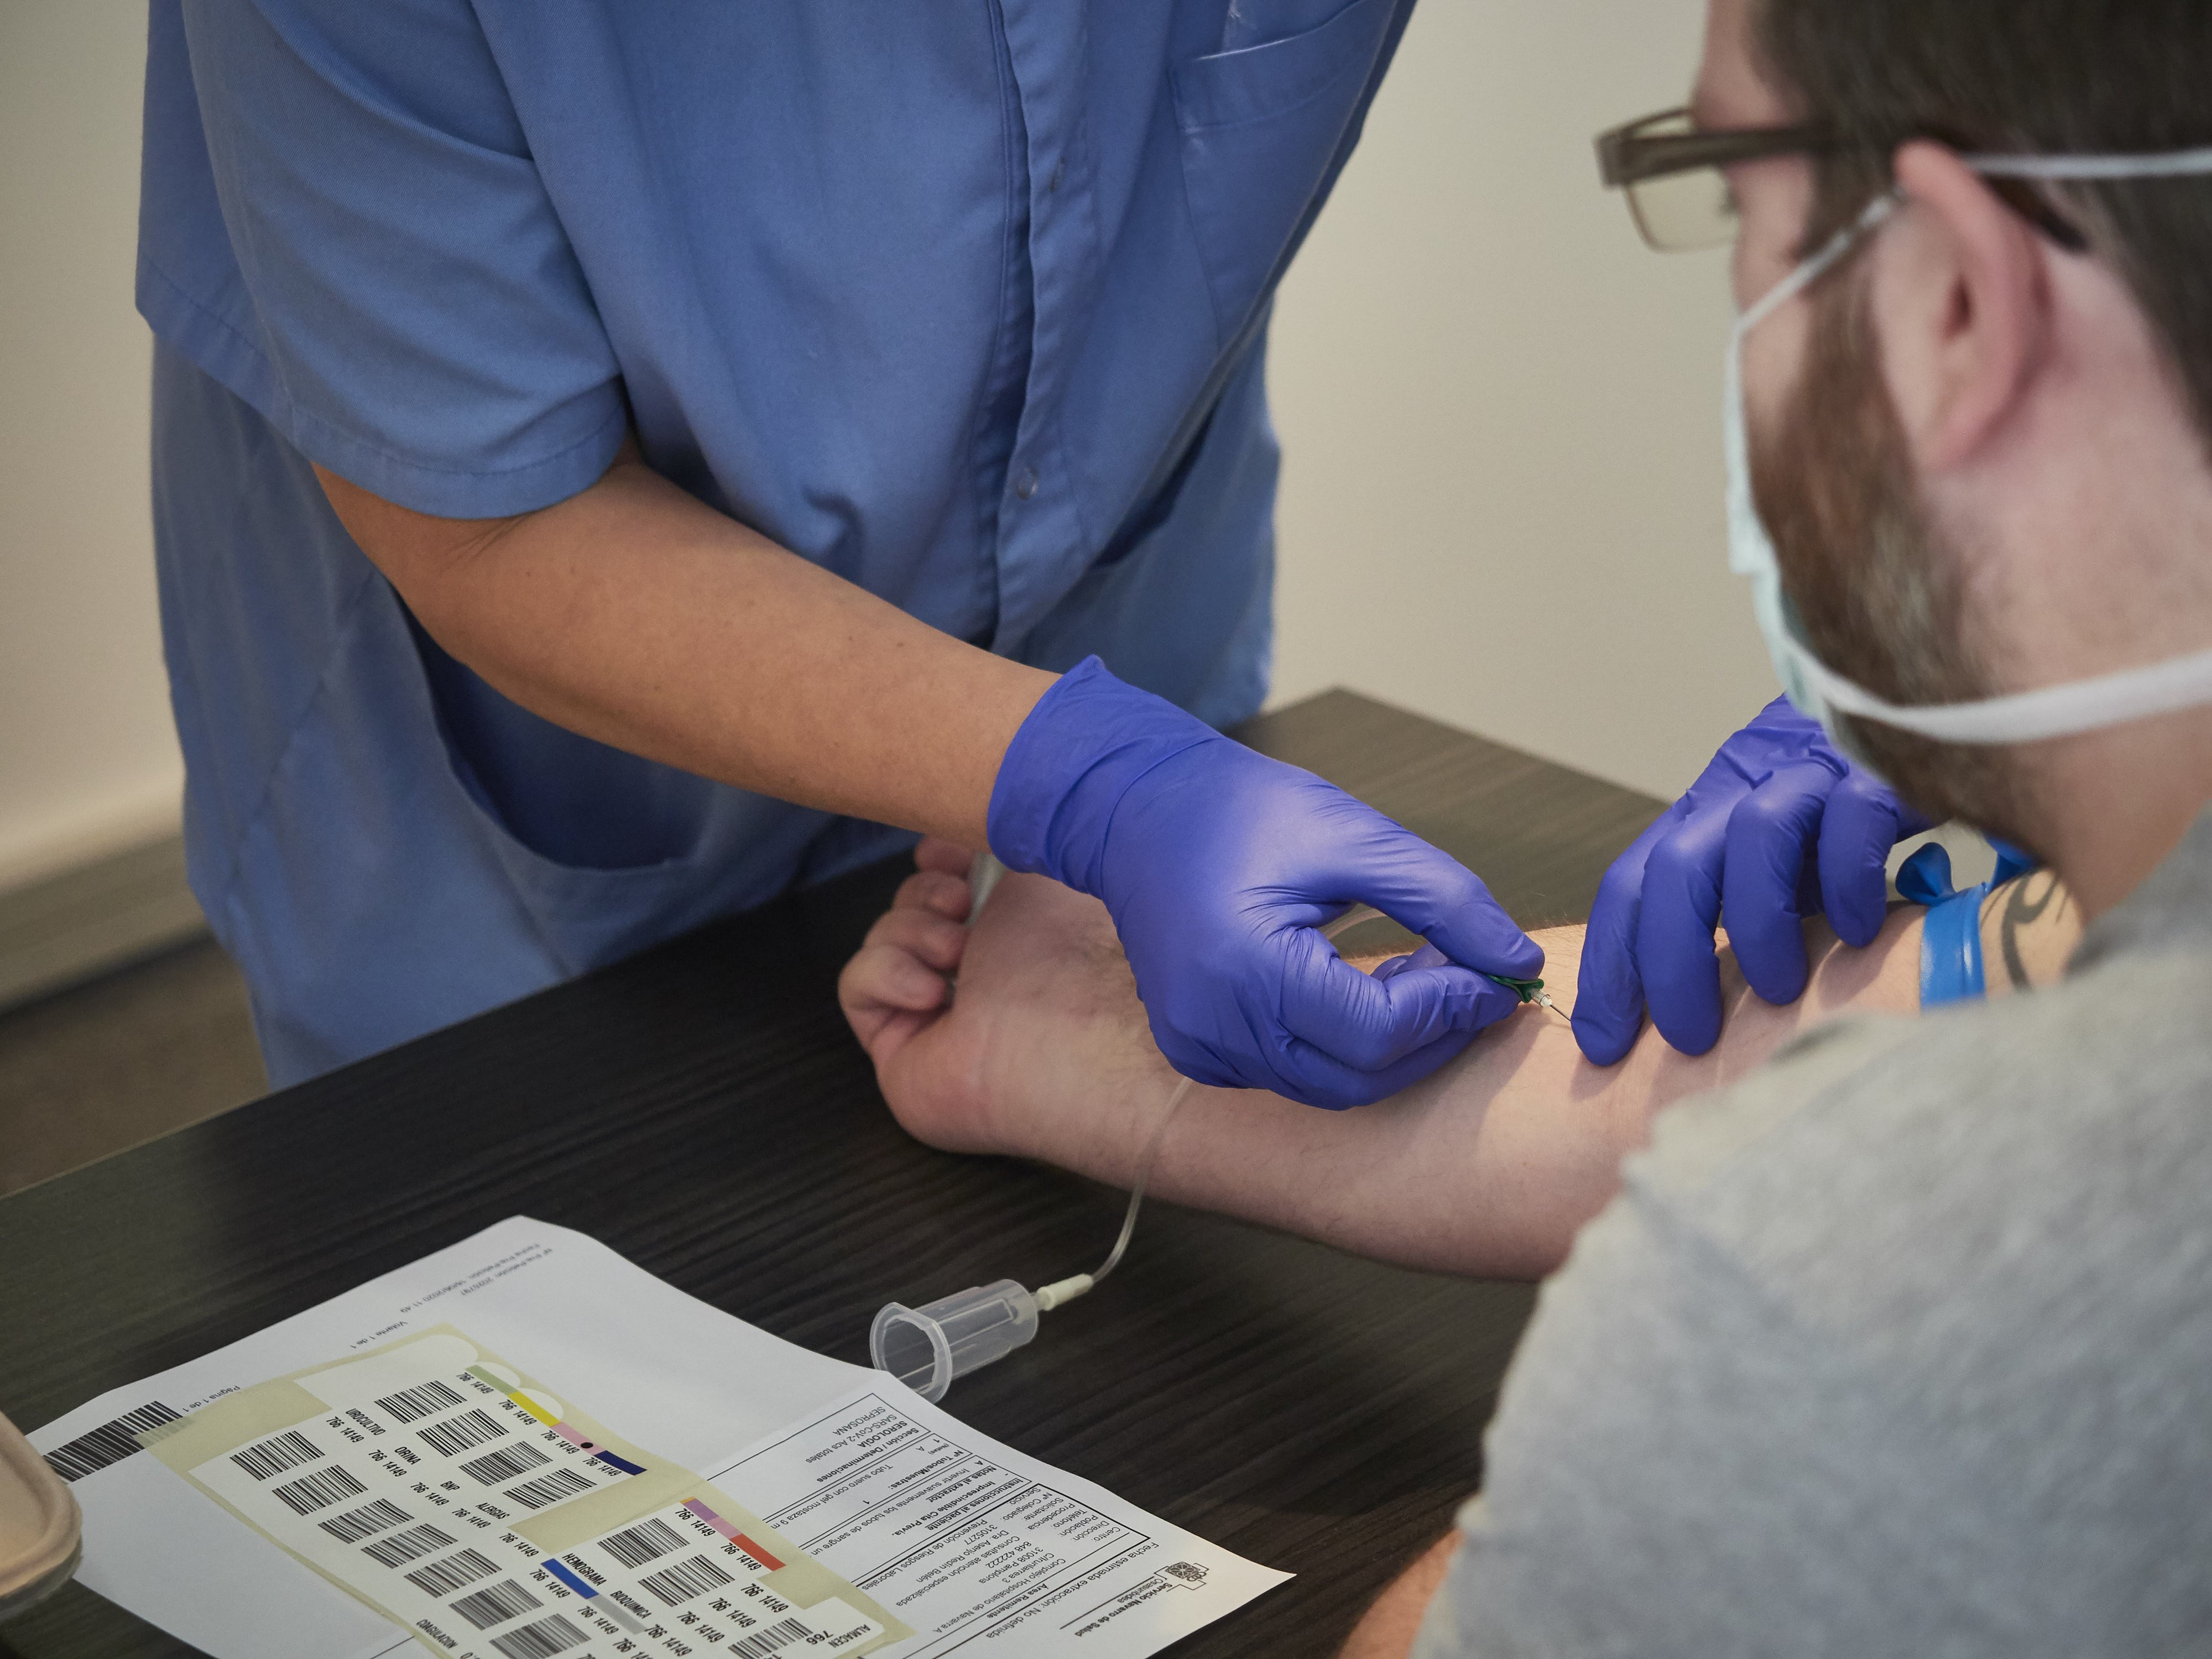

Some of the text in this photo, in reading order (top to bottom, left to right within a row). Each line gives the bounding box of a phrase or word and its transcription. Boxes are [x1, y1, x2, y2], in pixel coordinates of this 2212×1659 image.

[375, 1321, 408, 1337] Volante
[208, 1385, 241, 1400] Página
[456, 1372, 494, 1394] 766 14149
[345, 1408, 386, 1436] UROCULTIVO
[498, 1399, 538, 1425] 766 14149
[832, 1406, 886, 1436] SEPROSANA
[326, 1416, 365, 1443] 766 14149
[805, 1414, 898, 1463] SARS-CoV-2 Acs totales
[856, 1421, 908, 1448] SEROLOGÍA
[885, 1428, 919, 1446] Sección
[540, 1430, 580, 1454] 766 14149
[927, 1443, 950, 1455] (Notas)
[953, 1449, 964, 1458] Nº
[368, 1449, 407, 1477] 766 14149
[394, 1446, 421, 1465] ORINA
[582, 1457, 622, 1477] 766 14149
[816, 1446, 884, 1483] Determinaciones
[848, 1474, 872, 1488] suero
[870, 1464, 894, 1475] Tubo
[888, 1455, 954, 1490] Tubos/Muestras:
[941, 1468, 971, 1484] Invertir
[410, 1482, 450, 1506] 766 14149
[440, 1481, 460, 1491] BNP
[832, 1486, 849, 1496] con
[895, 1481, 942, 1507] suavemente
[925, 1465, 998, 1503] Notas al extractor
[819, 1493, 834, 1504] gel
[924, 1477, 1024, 1531] Instrucciones al paciente
[1004, 1486, 1041, 1506] Servicio:
[452, 1508, 491, 1528] 766 14149
[475, 1503, 510, 1520] ALERGIAS
[786, 1501, 822, 1521] mostaza
[861, 1513, 886, 1526] tubos
[883, 1506, 899, 1514] los
[891, 1480, 997, 1536] Imprescindible Cita Previa.
[1000, 1499, 1042, 1522] Colegiado:
[675, 1508, 716, 1537] 766 14149
[943, 1519, 988, 1544] Prevención
[1070, 1520, 1110, 1542] Dirección:
[499, 1533, 539, 1557] 766 14149
[822, 1532, 851, 1549] sangre
[915, 1497, 1065, 1583] Solicitante: Dra. Asenjo Redín Belén
[963, 1524, 998, 1546] 3105277
[984, 1509, 1088, 1569] Teléfono: 848 422222
[1091, 1526, 1121, 1543] Centro:
[721, 1543, 762, 1571] 766 14149
[895, 1548, 935, 1568] Riesgos
[978, 1514, 1099, 1584] Población: 31008 Pamplona
[980, 1536, 1020, 1558] Consultas
[562, 1553, 607, 1586] HEMOGRAMA
[862, 1567, 903, 1590] Laborales
[947, 1557, 982, 1577] atención
[1028, 1558, 1066, 1579] Complejo
[529, 1568, 571, 1598] 766 14149
[895, 1575, 949, 1606] especializada
[983, 1578, 1031, 1605] Hospitalario
[985, 1542, 1160, 1639] Fecha estimada extracción: No definida
[1139, 1582, 1173, 1600] Servicio
[609, 1590, 652, 1619] BIOQUIMICA
[740, 1583, 789, 1613] 766 14149
[983, 1583, 1049, 1619] Área Remitente
[1108, 1599, 1143, 1618] Navarro
[577, 1605, 619, 1635] 766 14149
[708, 1597, 757, 1628] 766 14149
[940, 1610, 975, 1629] Navarra
[676, 1610, 726, 1643] 766 14149
[806, 1630, 834, 1645] 766
[828, 1624, 870, 1648] ALMACEN
[1074, 1622, 1101, 1637] Salud
[612, 1637, 637, 1653] 766
[644, 1624, 668, 1639] 766
[661, 1637, 693, 1657] 14149
